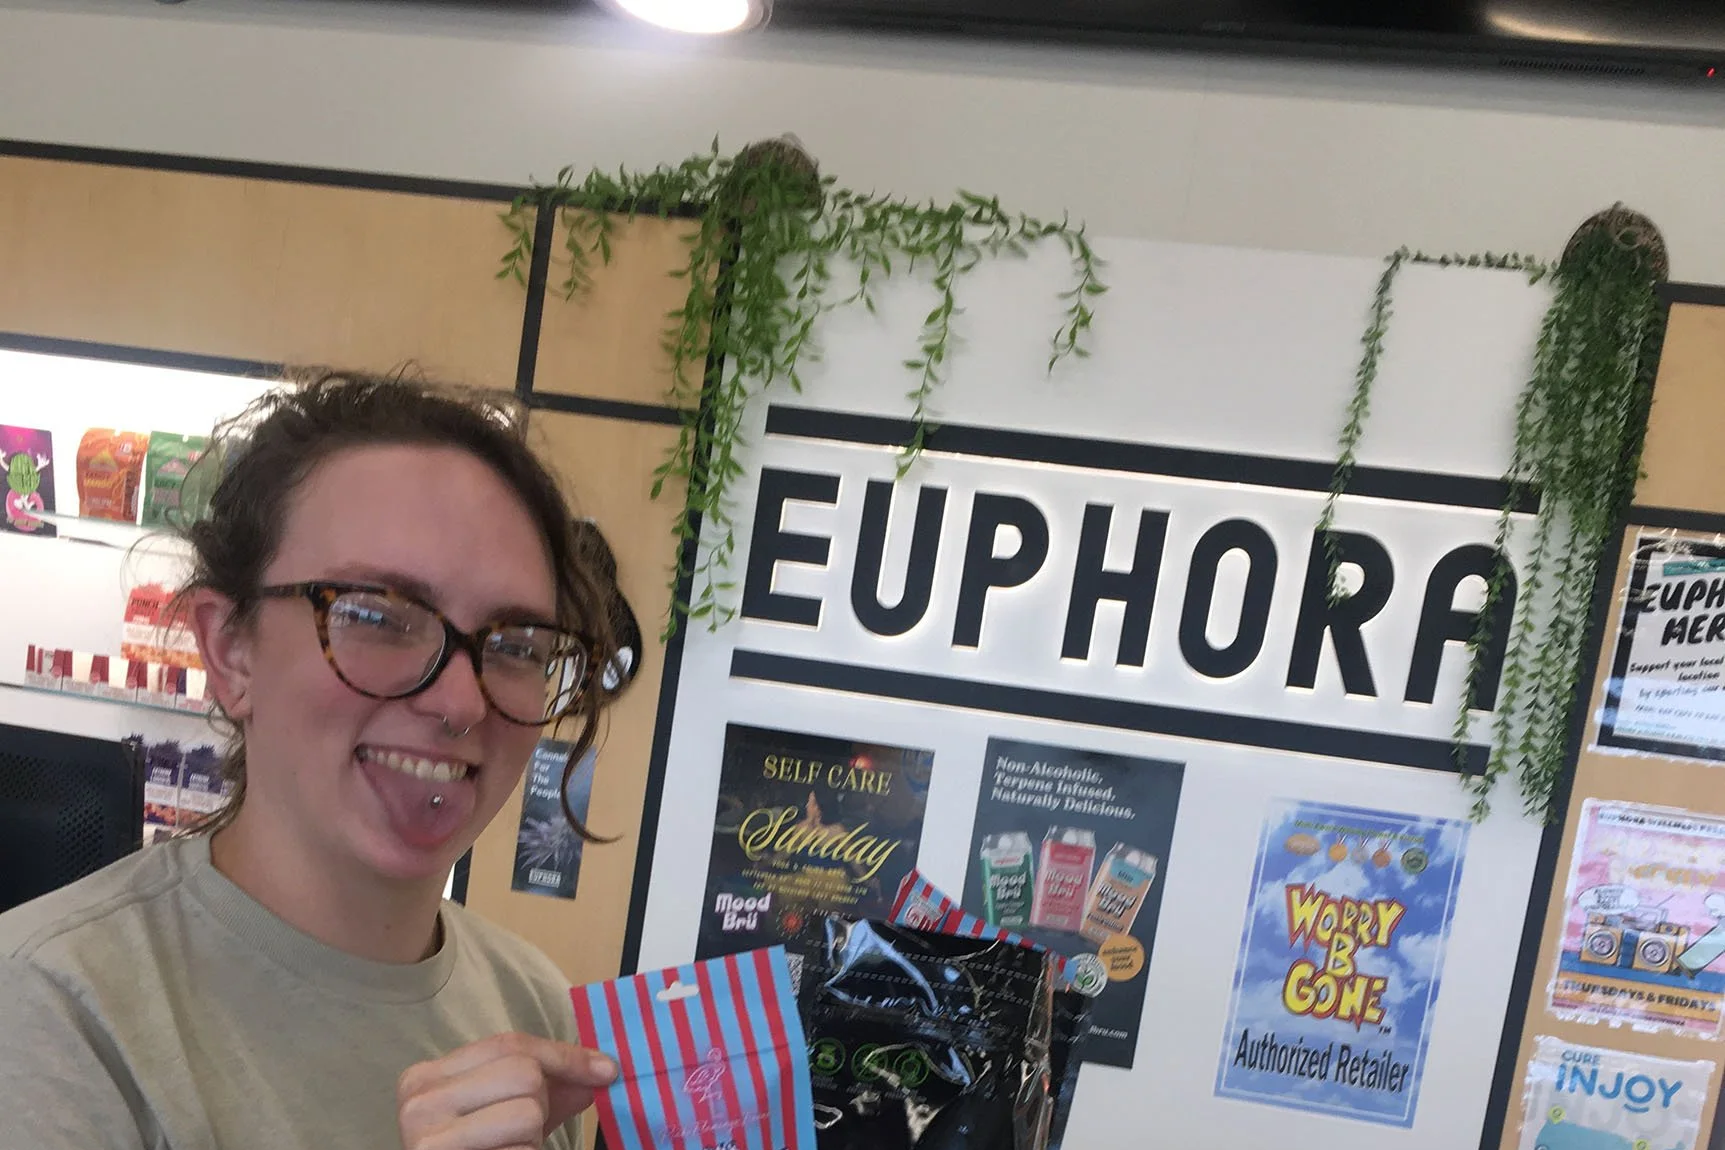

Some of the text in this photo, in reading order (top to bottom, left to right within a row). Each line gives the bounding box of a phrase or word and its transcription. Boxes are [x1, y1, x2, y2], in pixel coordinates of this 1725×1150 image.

[741, 467, 1519, 712] EUPHORA
[1630, 659, 1671, 674] Support
[1673, 660, 1698, 672] your
[1677, 670, 1720, 681] location
[763, 754, 893, 797] SELF CARE
[994, 770, 1044, 793] Terpene
[996, 756, 1103, 784] Non-Alcoholic,
[991, 786, 1061, 811] Naturally
[738, 805, 901, 884] Sunday
[714, 892, 772, 914] Mood
[722, 910, 758, 931] Brü
[1285, 883, 1408, 949] WORRY
[1328, 932, 1356, 977] B
[1282, 958, 1388, 1027] GONE
[1232, 1029, 1411, 1094] Authorized Retailer
[1555, 1063, 1684, 1110] INJOY
